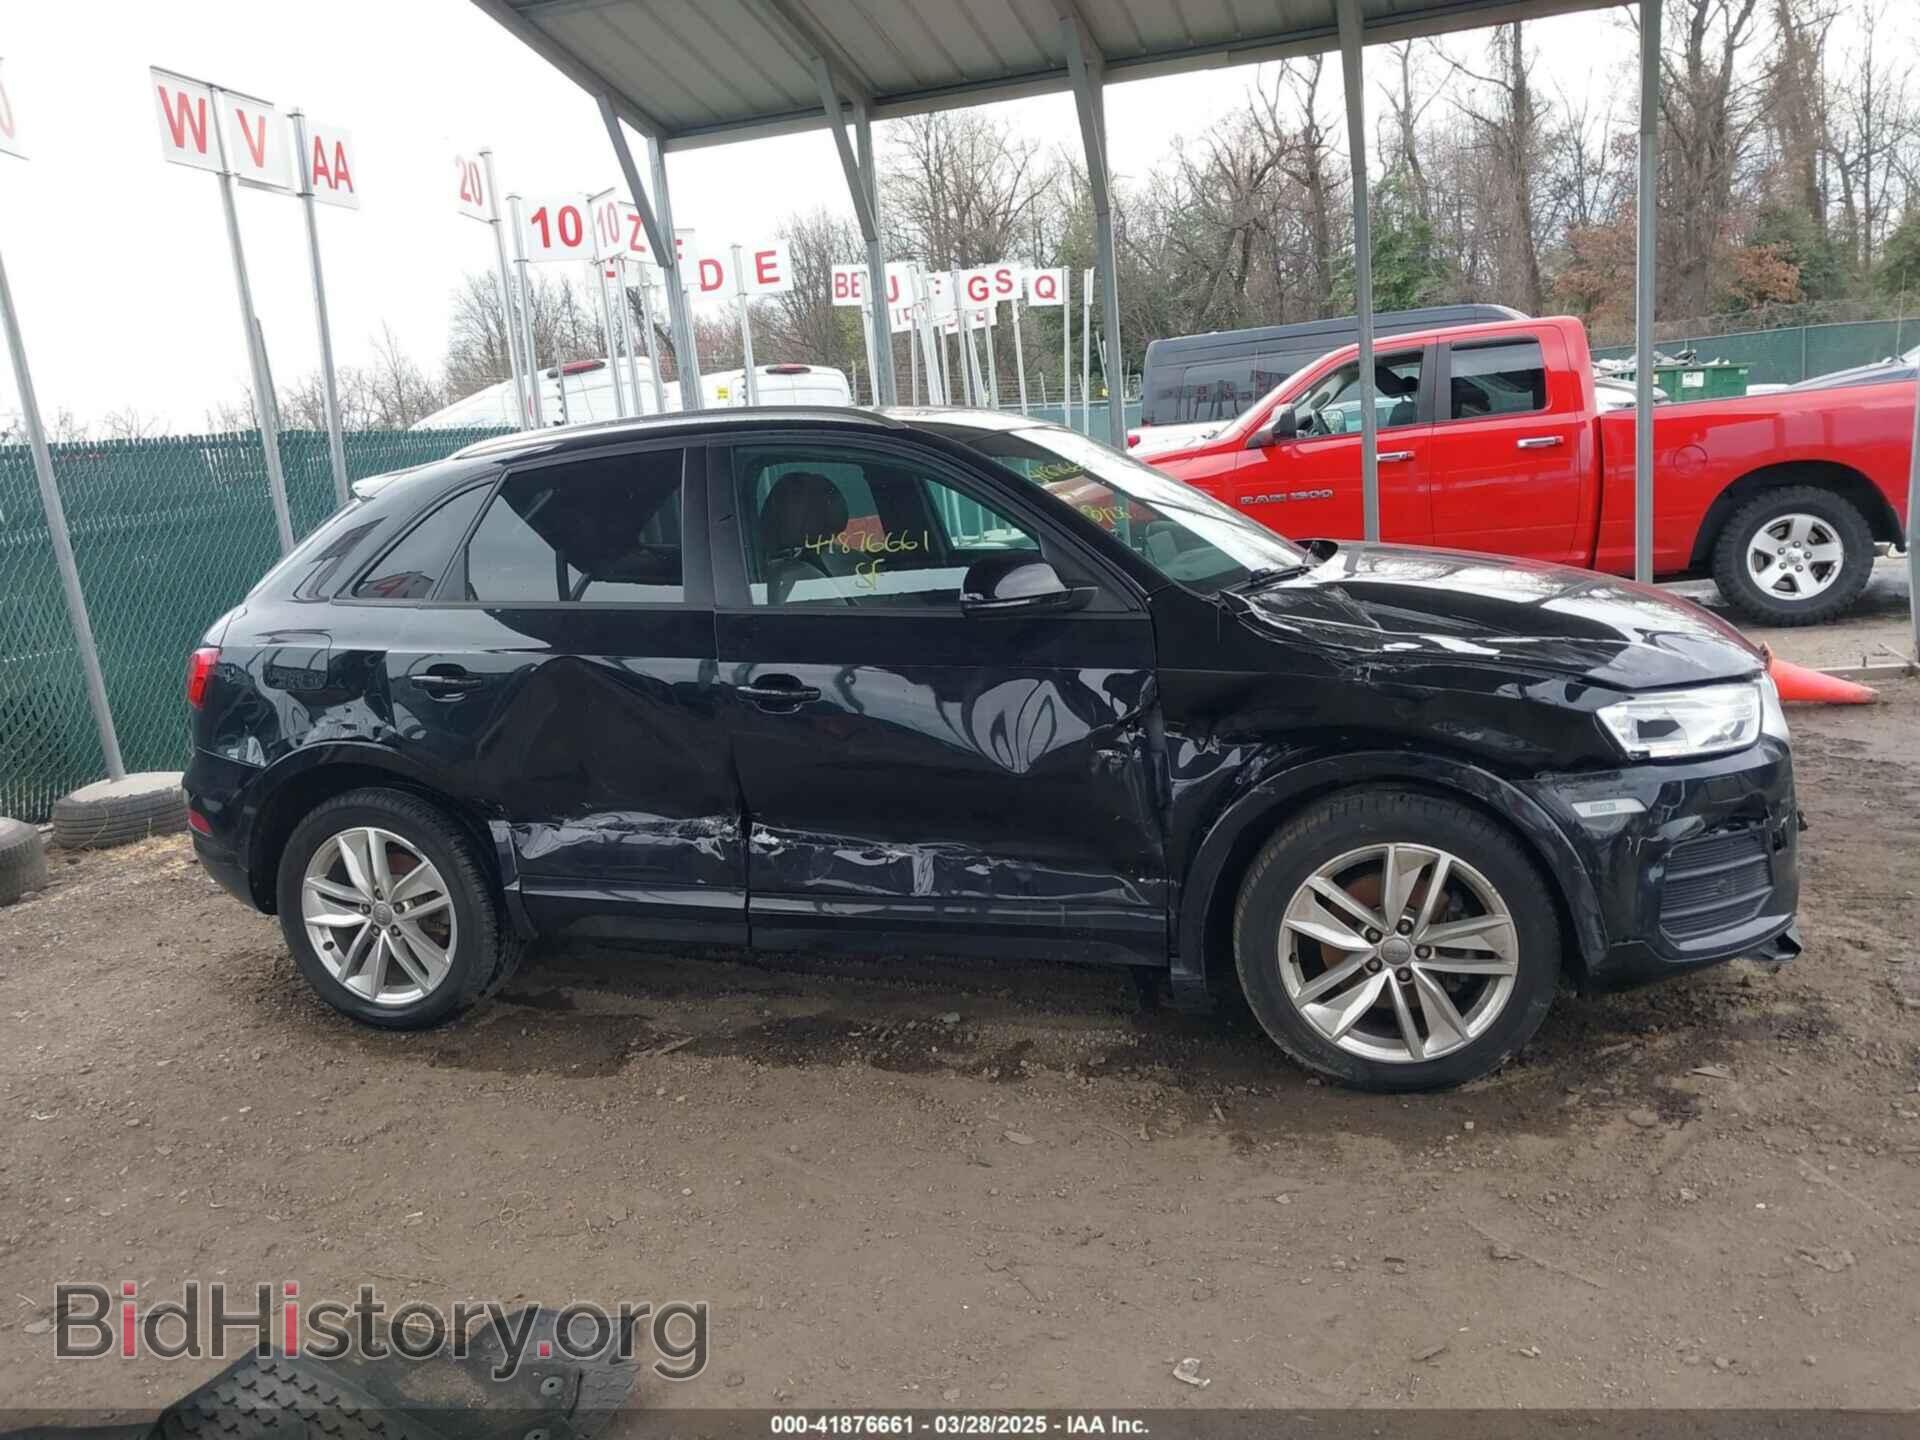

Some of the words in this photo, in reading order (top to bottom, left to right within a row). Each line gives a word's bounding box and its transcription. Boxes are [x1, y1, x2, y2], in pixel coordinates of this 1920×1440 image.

[158, 84, 207, 155] W
[236, 108, 266, 169] V
[312, 135, 354, 193] AA
[456, 155, 484, 207] 20
[531, 204, 583, 249] 10
[597, 201, 620, 249] 10
[627, 213, 647, 253] Z
[698, 258, 724, 292] D
[754, 250, 781, 285] E
[995, 268, 1013, 294] S
[887, 275, 900, 302] J
[967, 275, 989, 302] G
[1034, 275, 1056, 300] Q
[1240, 493, 1287, 504] RAM
[805, 529, 929, 555] 41876661
